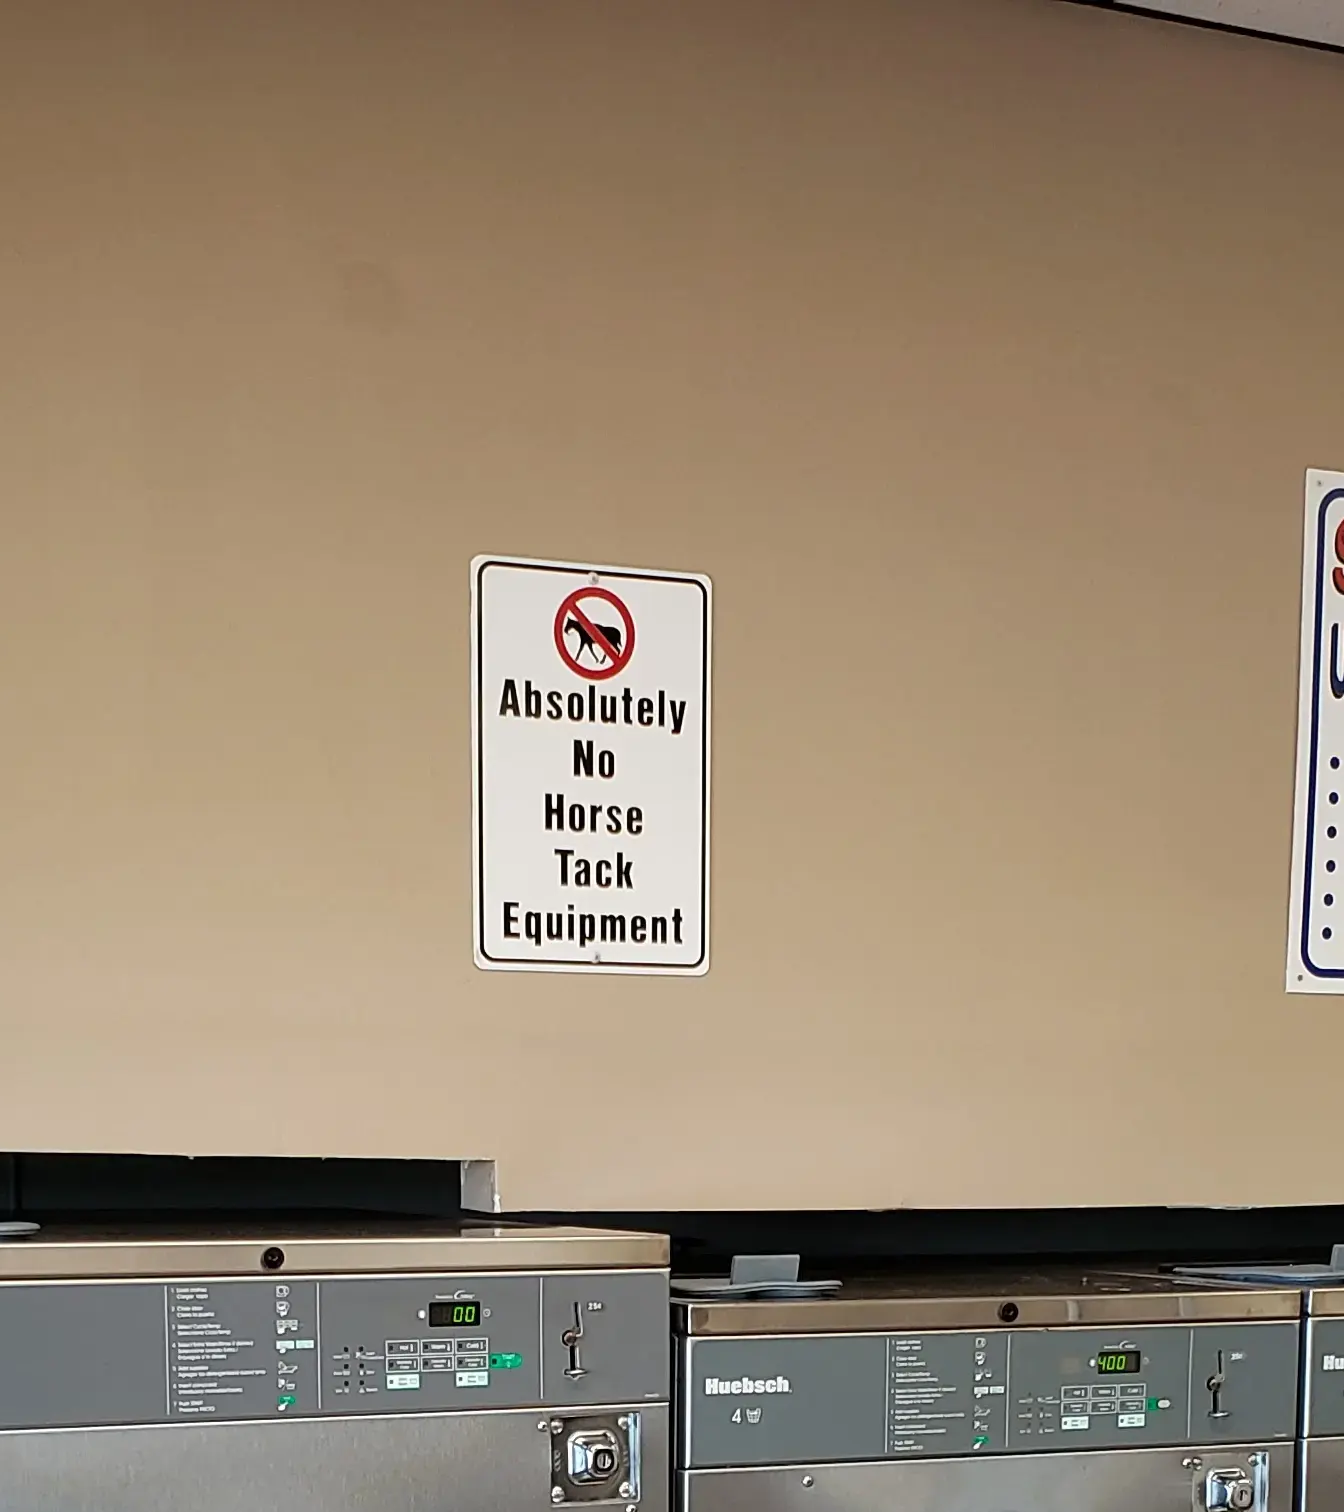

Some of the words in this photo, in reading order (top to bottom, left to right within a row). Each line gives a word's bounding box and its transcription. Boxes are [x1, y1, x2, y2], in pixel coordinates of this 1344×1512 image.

[499, 678, 687, 735] Absolutely
[573, 739, 615, 779] No
[544, 793, 643, 835] Horse
[554, 848, 633, 889] Tack
[503, 901, 683, 948] Equipment
[453, 1306, 476, 1323] 00
[1097, 1355, 1126, 1371] 400
[704, 1376, 790, 1395] Huebsch
[731, 1408, 742, 1424] 4
